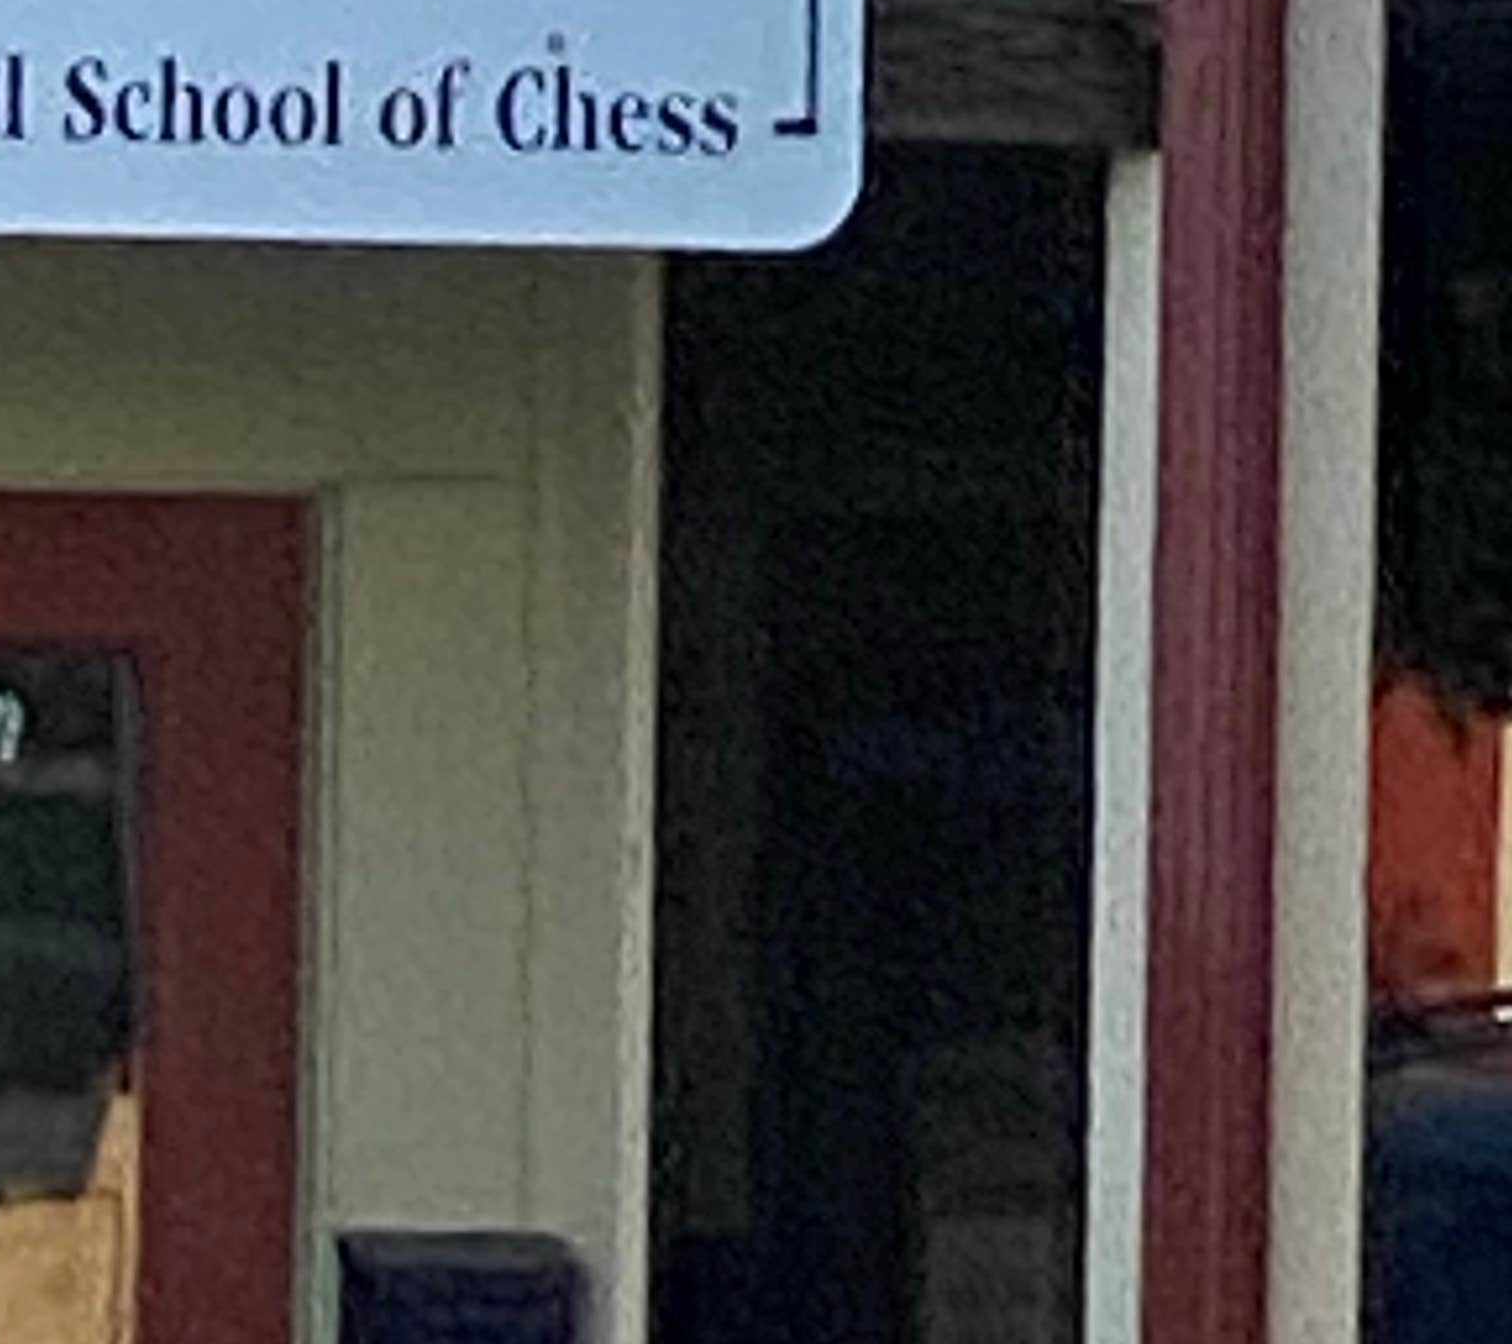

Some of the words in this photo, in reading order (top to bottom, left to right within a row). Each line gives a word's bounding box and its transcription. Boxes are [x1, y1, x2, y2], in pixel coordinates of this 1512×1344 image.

[61, 54, 344, 148] School
[377, 58, 473, 152] of
[493, 63, 741, 158] Chess
